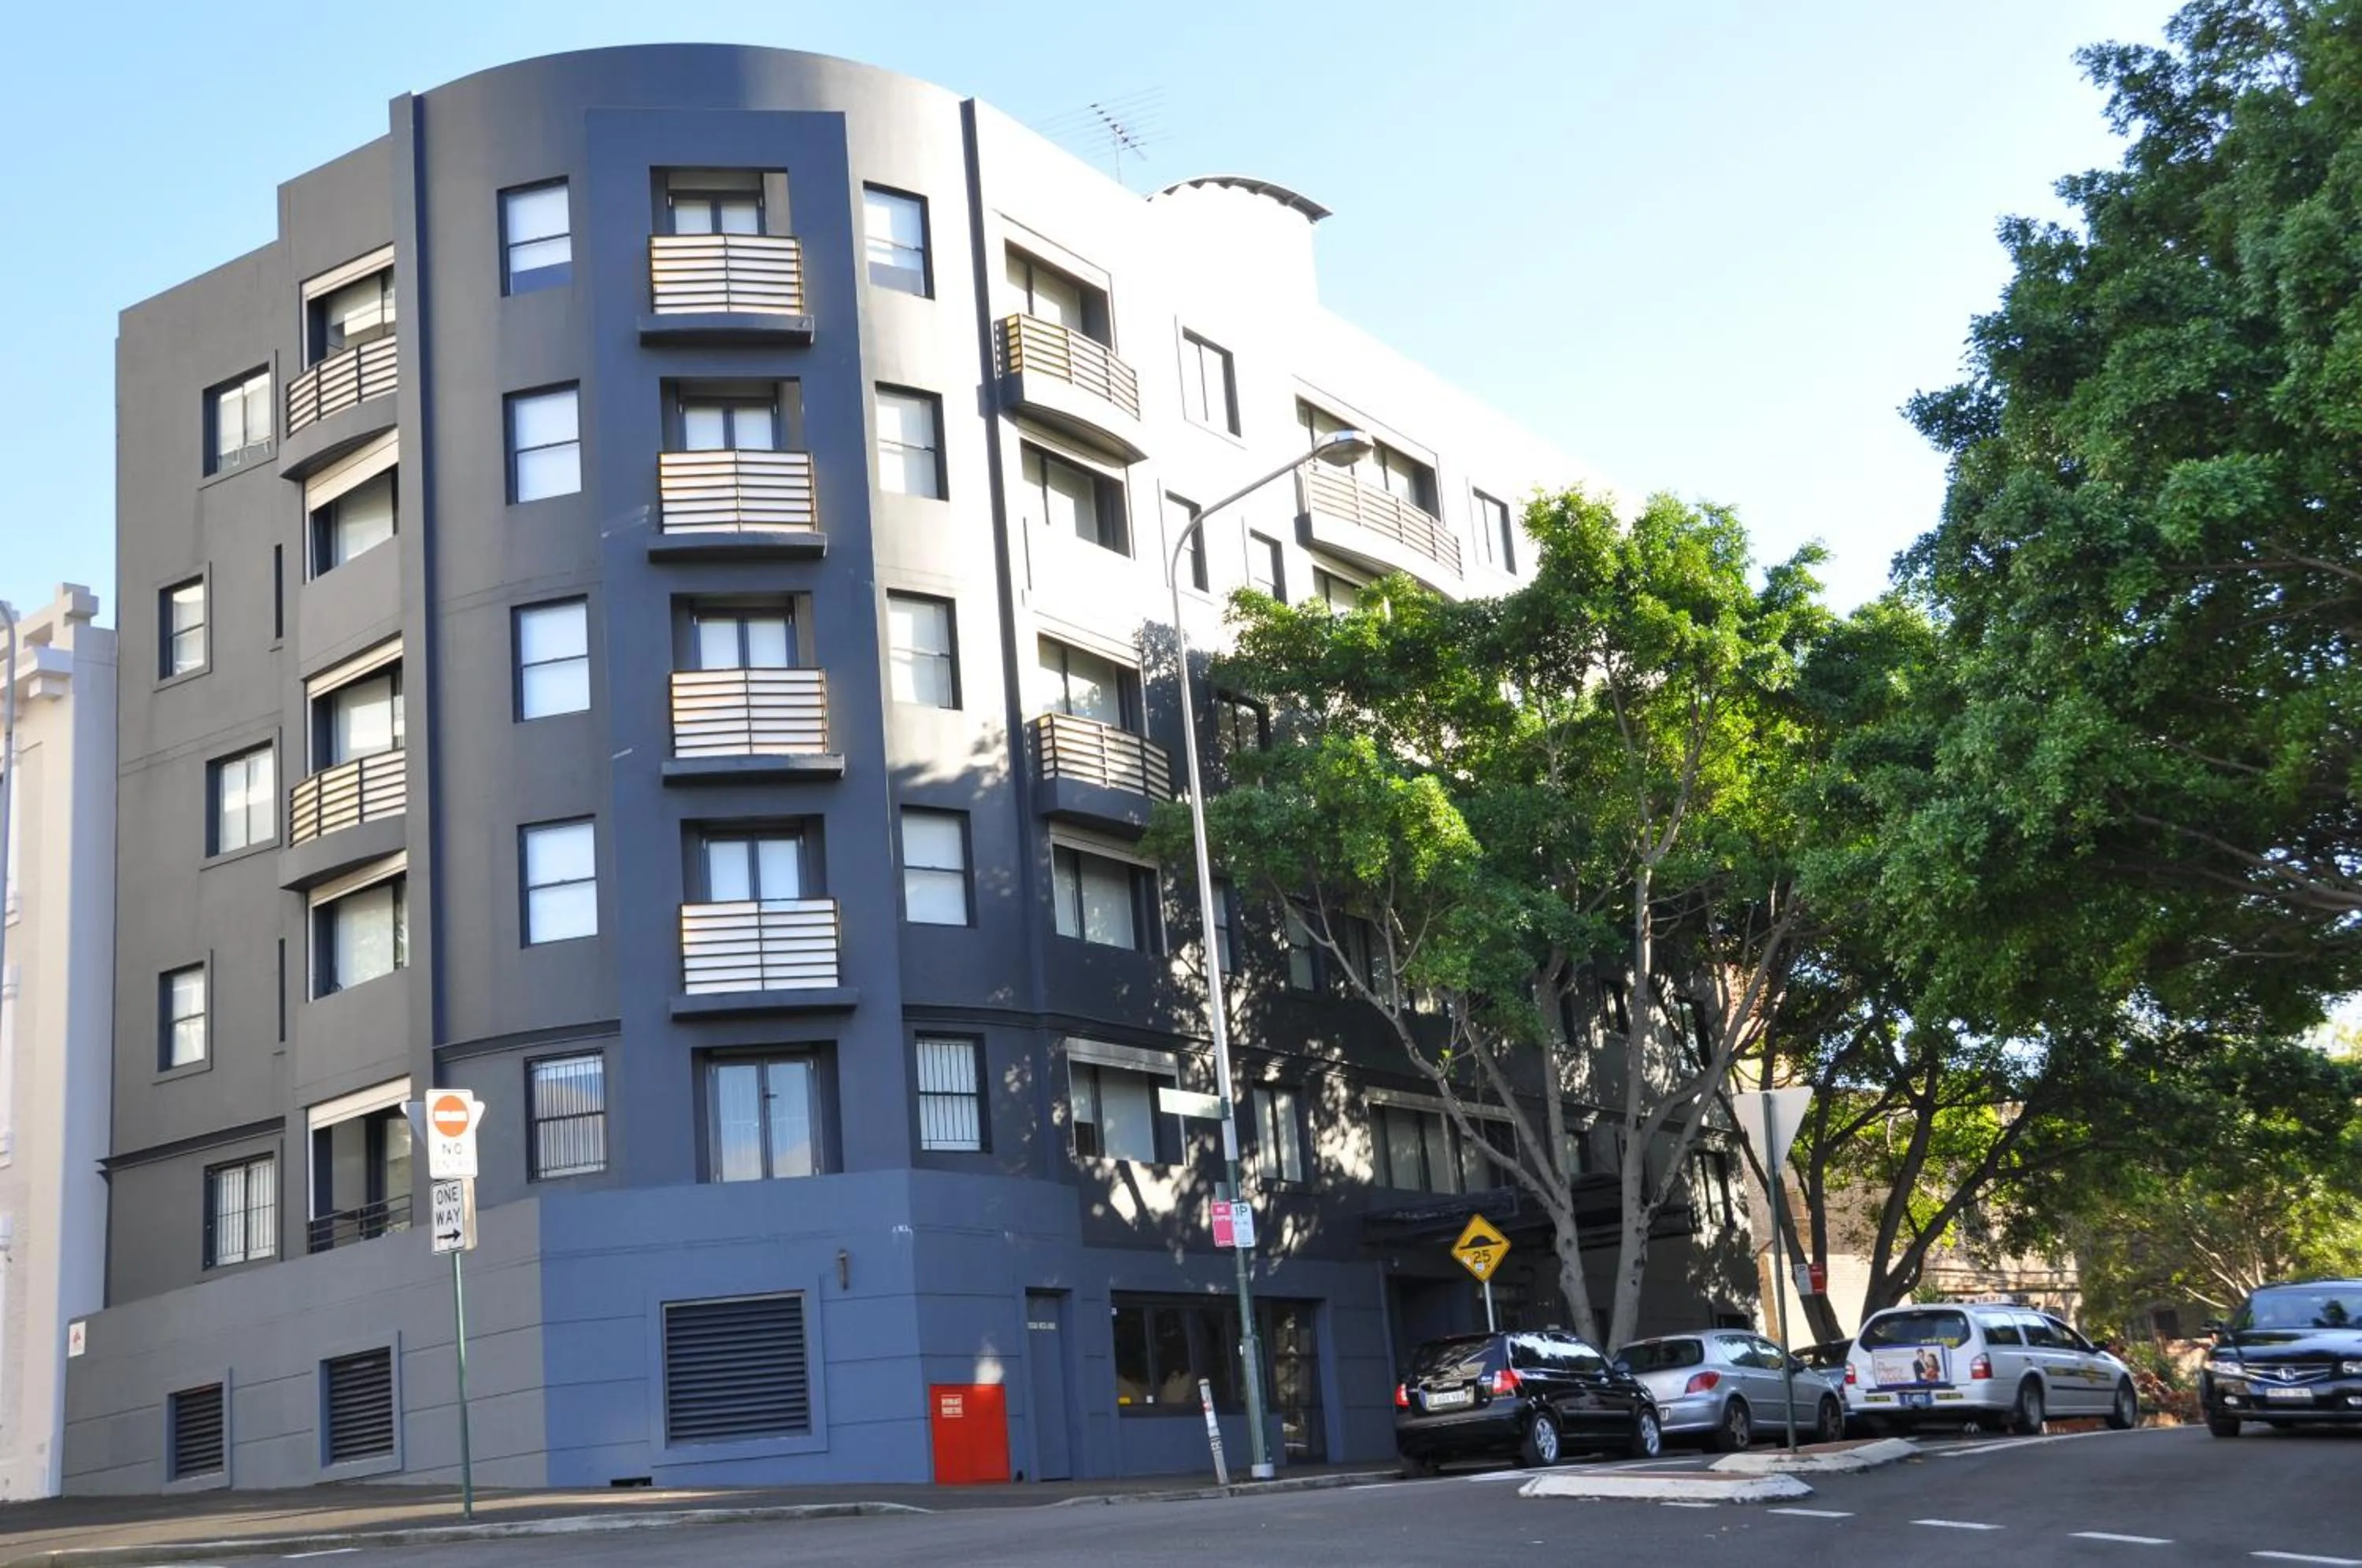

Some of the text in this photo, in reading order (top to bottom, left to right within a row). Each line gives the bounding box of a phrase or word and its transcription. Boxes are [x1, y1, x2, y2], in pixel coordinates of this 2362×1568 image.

[442, 1142, 462, 1155] NO
[436, 1186, 459, 1205] ONE
[435, 1207, 461, 1228] WAY
[1473, 1249, 1491, 1264] 25
